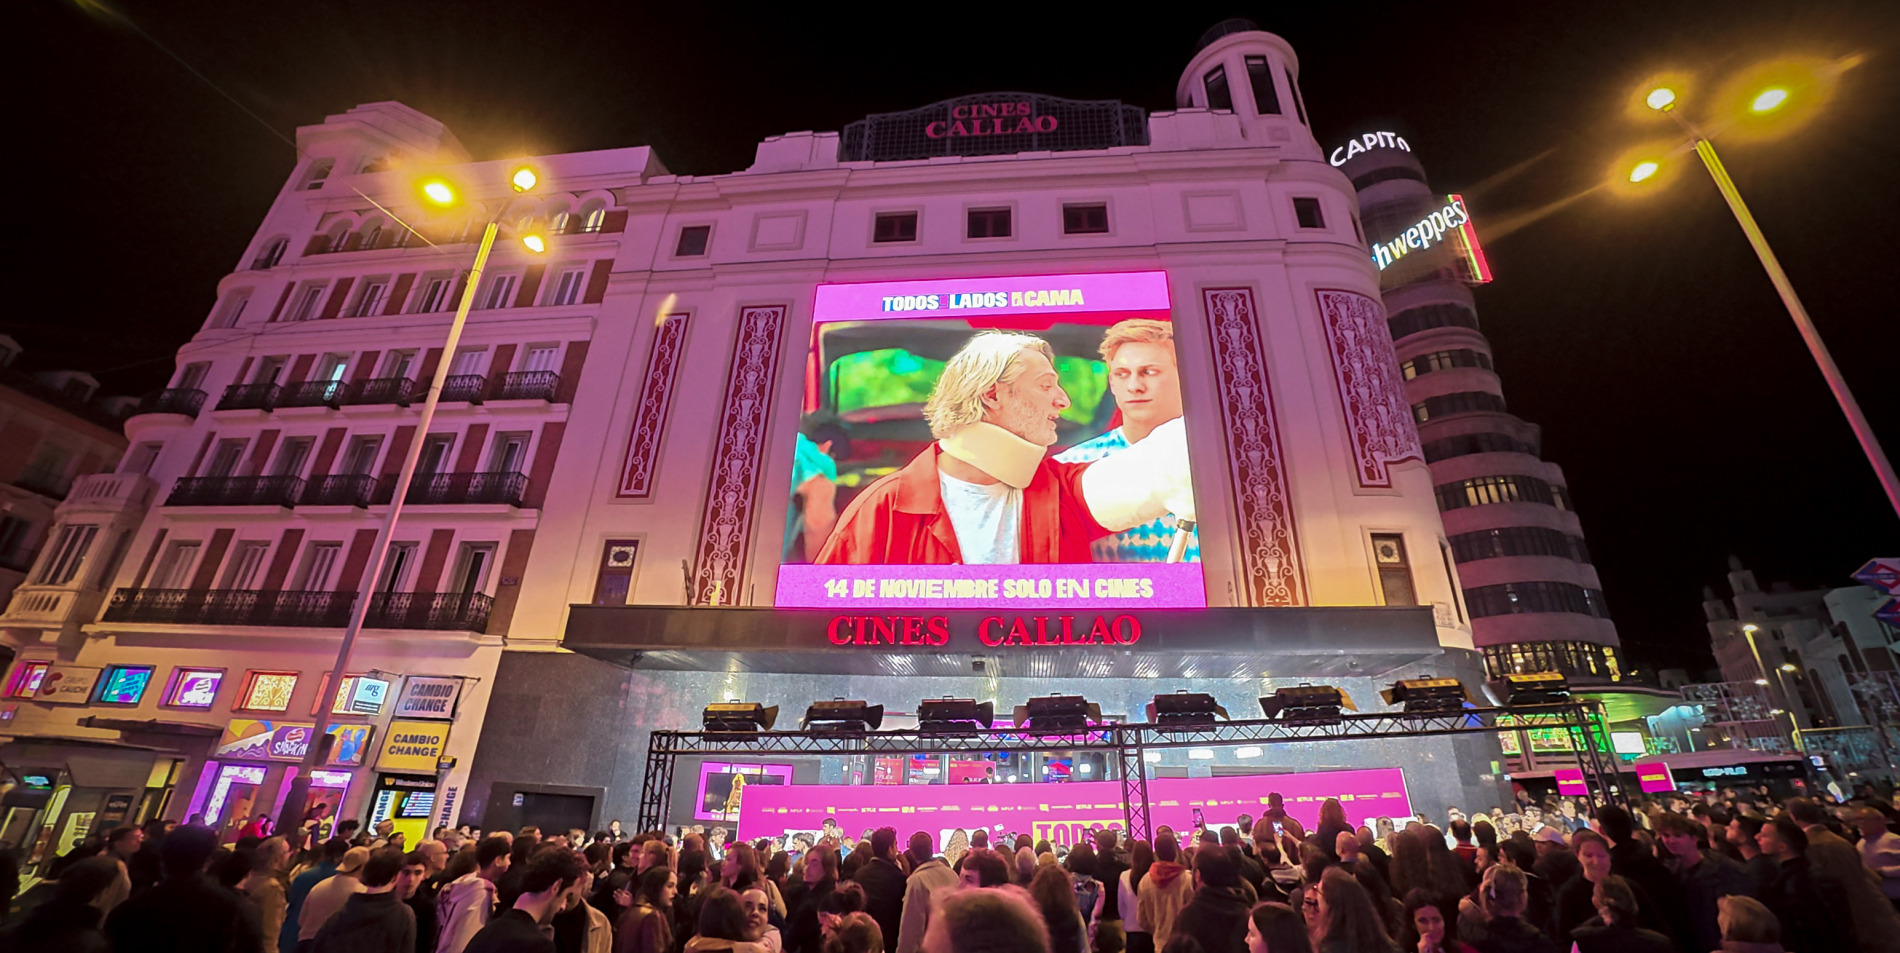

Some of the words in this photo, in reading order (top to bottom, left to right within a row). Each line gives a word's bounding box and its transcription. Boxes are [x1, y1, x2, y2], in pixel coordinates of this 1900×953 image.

[952, 102, 1031, 119] CINES
[926, 115, 1058, 138] CALLAO
[1371, 201, 1468, 271] hweppes
[882, 295, 939, 311] TODOS
[949, 292, 1008, 309] LADOS
[1024, 289, 1084, 306] CAMA
[824, 579, 849, 598] 14
[853, 579, 876, 598] DE
[879, 579, 998, 598] NOVIEMBRE
[1003, 579, 1052, 598] SOLO
[1056, 579, 1090, 598] EN
[1095, 579, 1154, 598] CINES
[827, 615, 949, 646] CINES
[978, 614, 1142, 646] CALLAO
[410, 683, 454, 698] CAMBIO
[403, 698, 448, 713] CHANGE
[393, 733, 440, 745] CAMBIO
[388, 745, 438, 757] CHANGE
[372, 790, 390, 829] CHANGE
[439, 786, 458, 828] CHANGE
